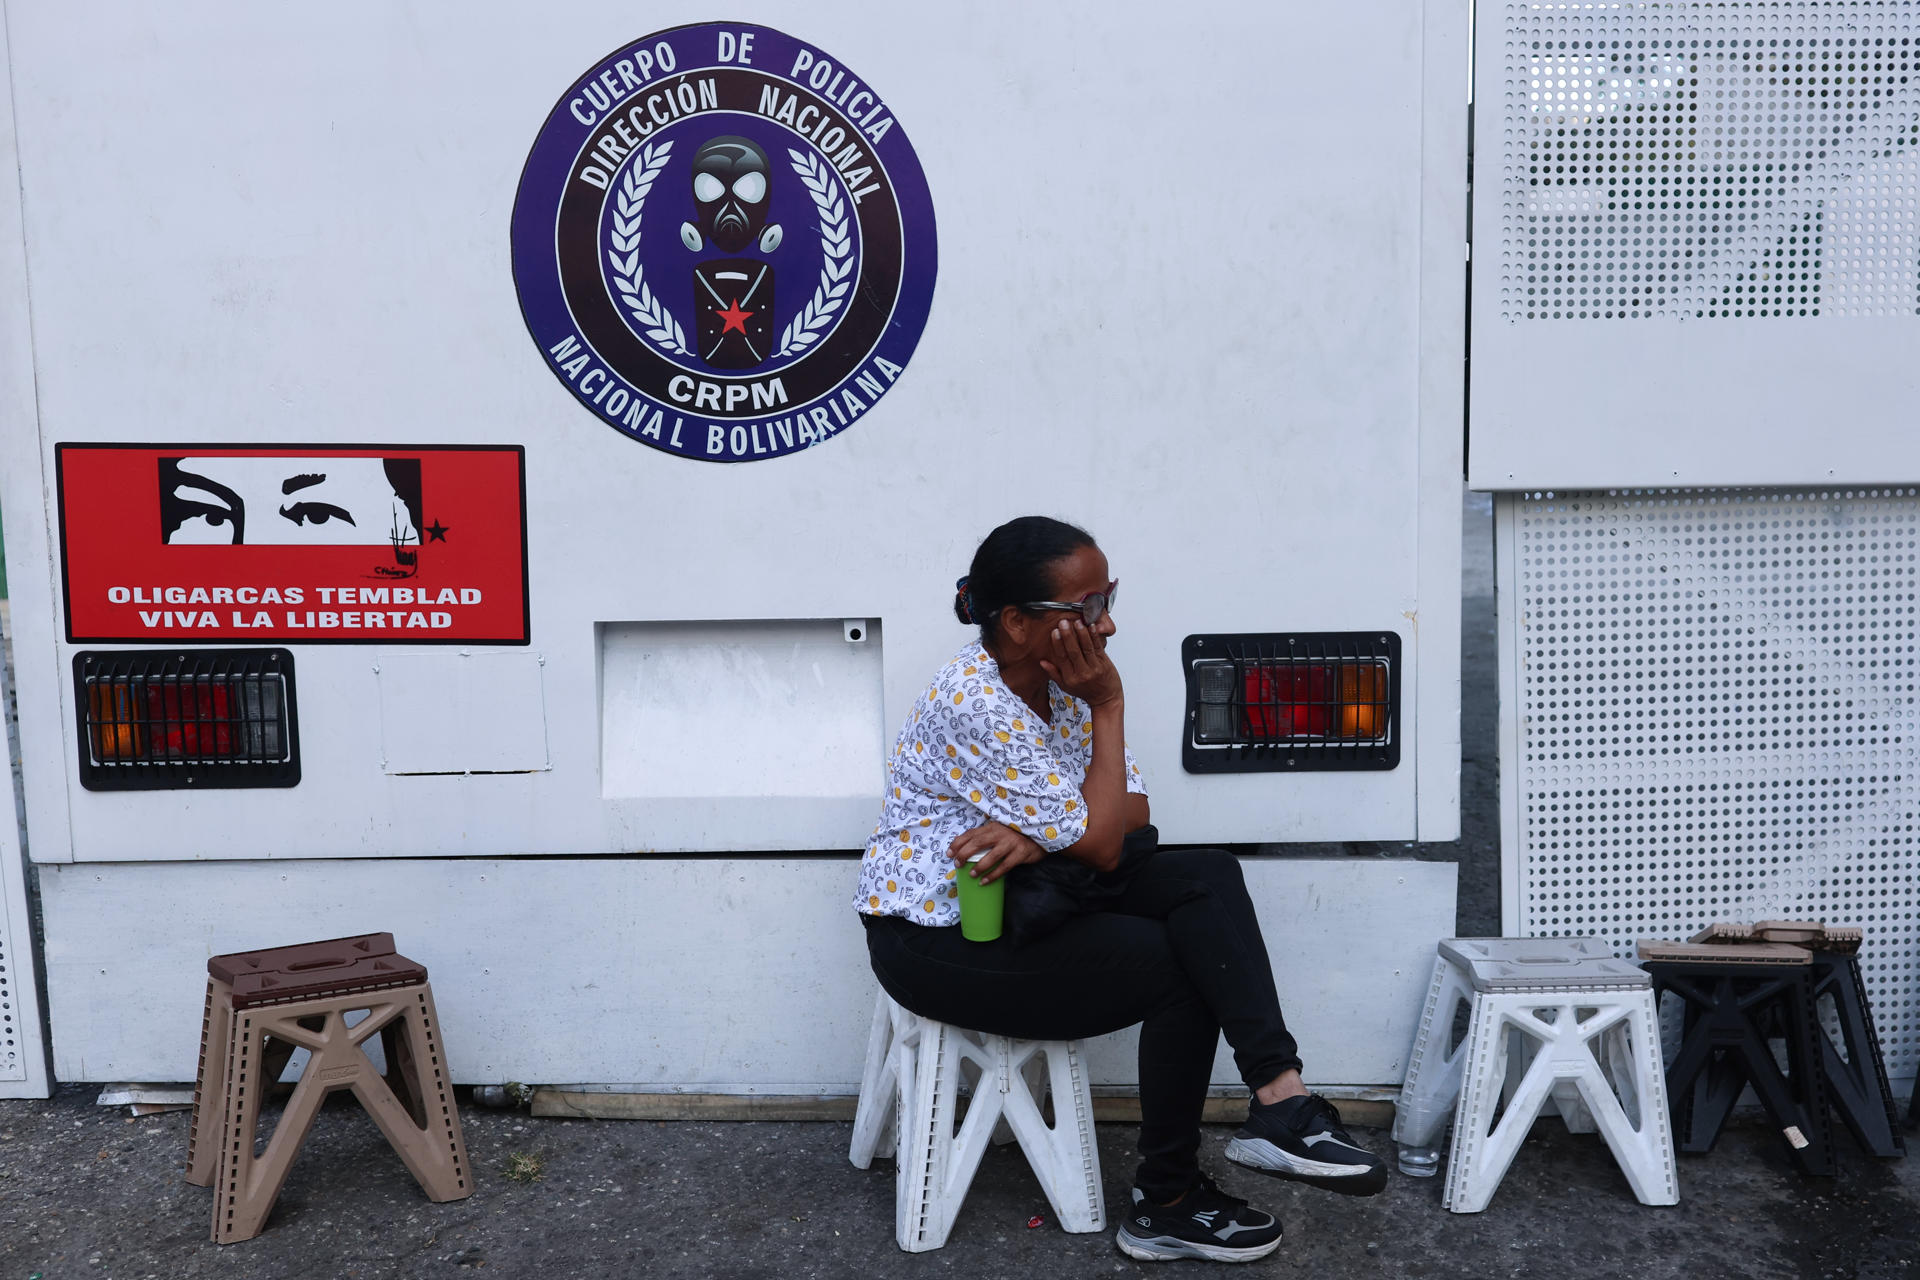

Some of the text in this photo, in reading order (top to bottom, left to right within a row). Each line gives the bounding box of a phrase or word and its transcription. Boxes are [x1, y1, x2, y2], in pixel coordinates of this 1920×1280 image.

[570, 42, 677, 126] CUERPO
[717, 32, 755, 64] DE
[580, 76, 881, 205] DIRECCIÓN NACIONAL
[550, 335, 903, 455] NACIONAL BOLIVARIANA
[668, 375, 789, 411] CRPM
[107, 586, 482, 605] OLIGARCAS TEMBLAD
[138, 611, 453, 629] VIVA LA LIBERTAD
